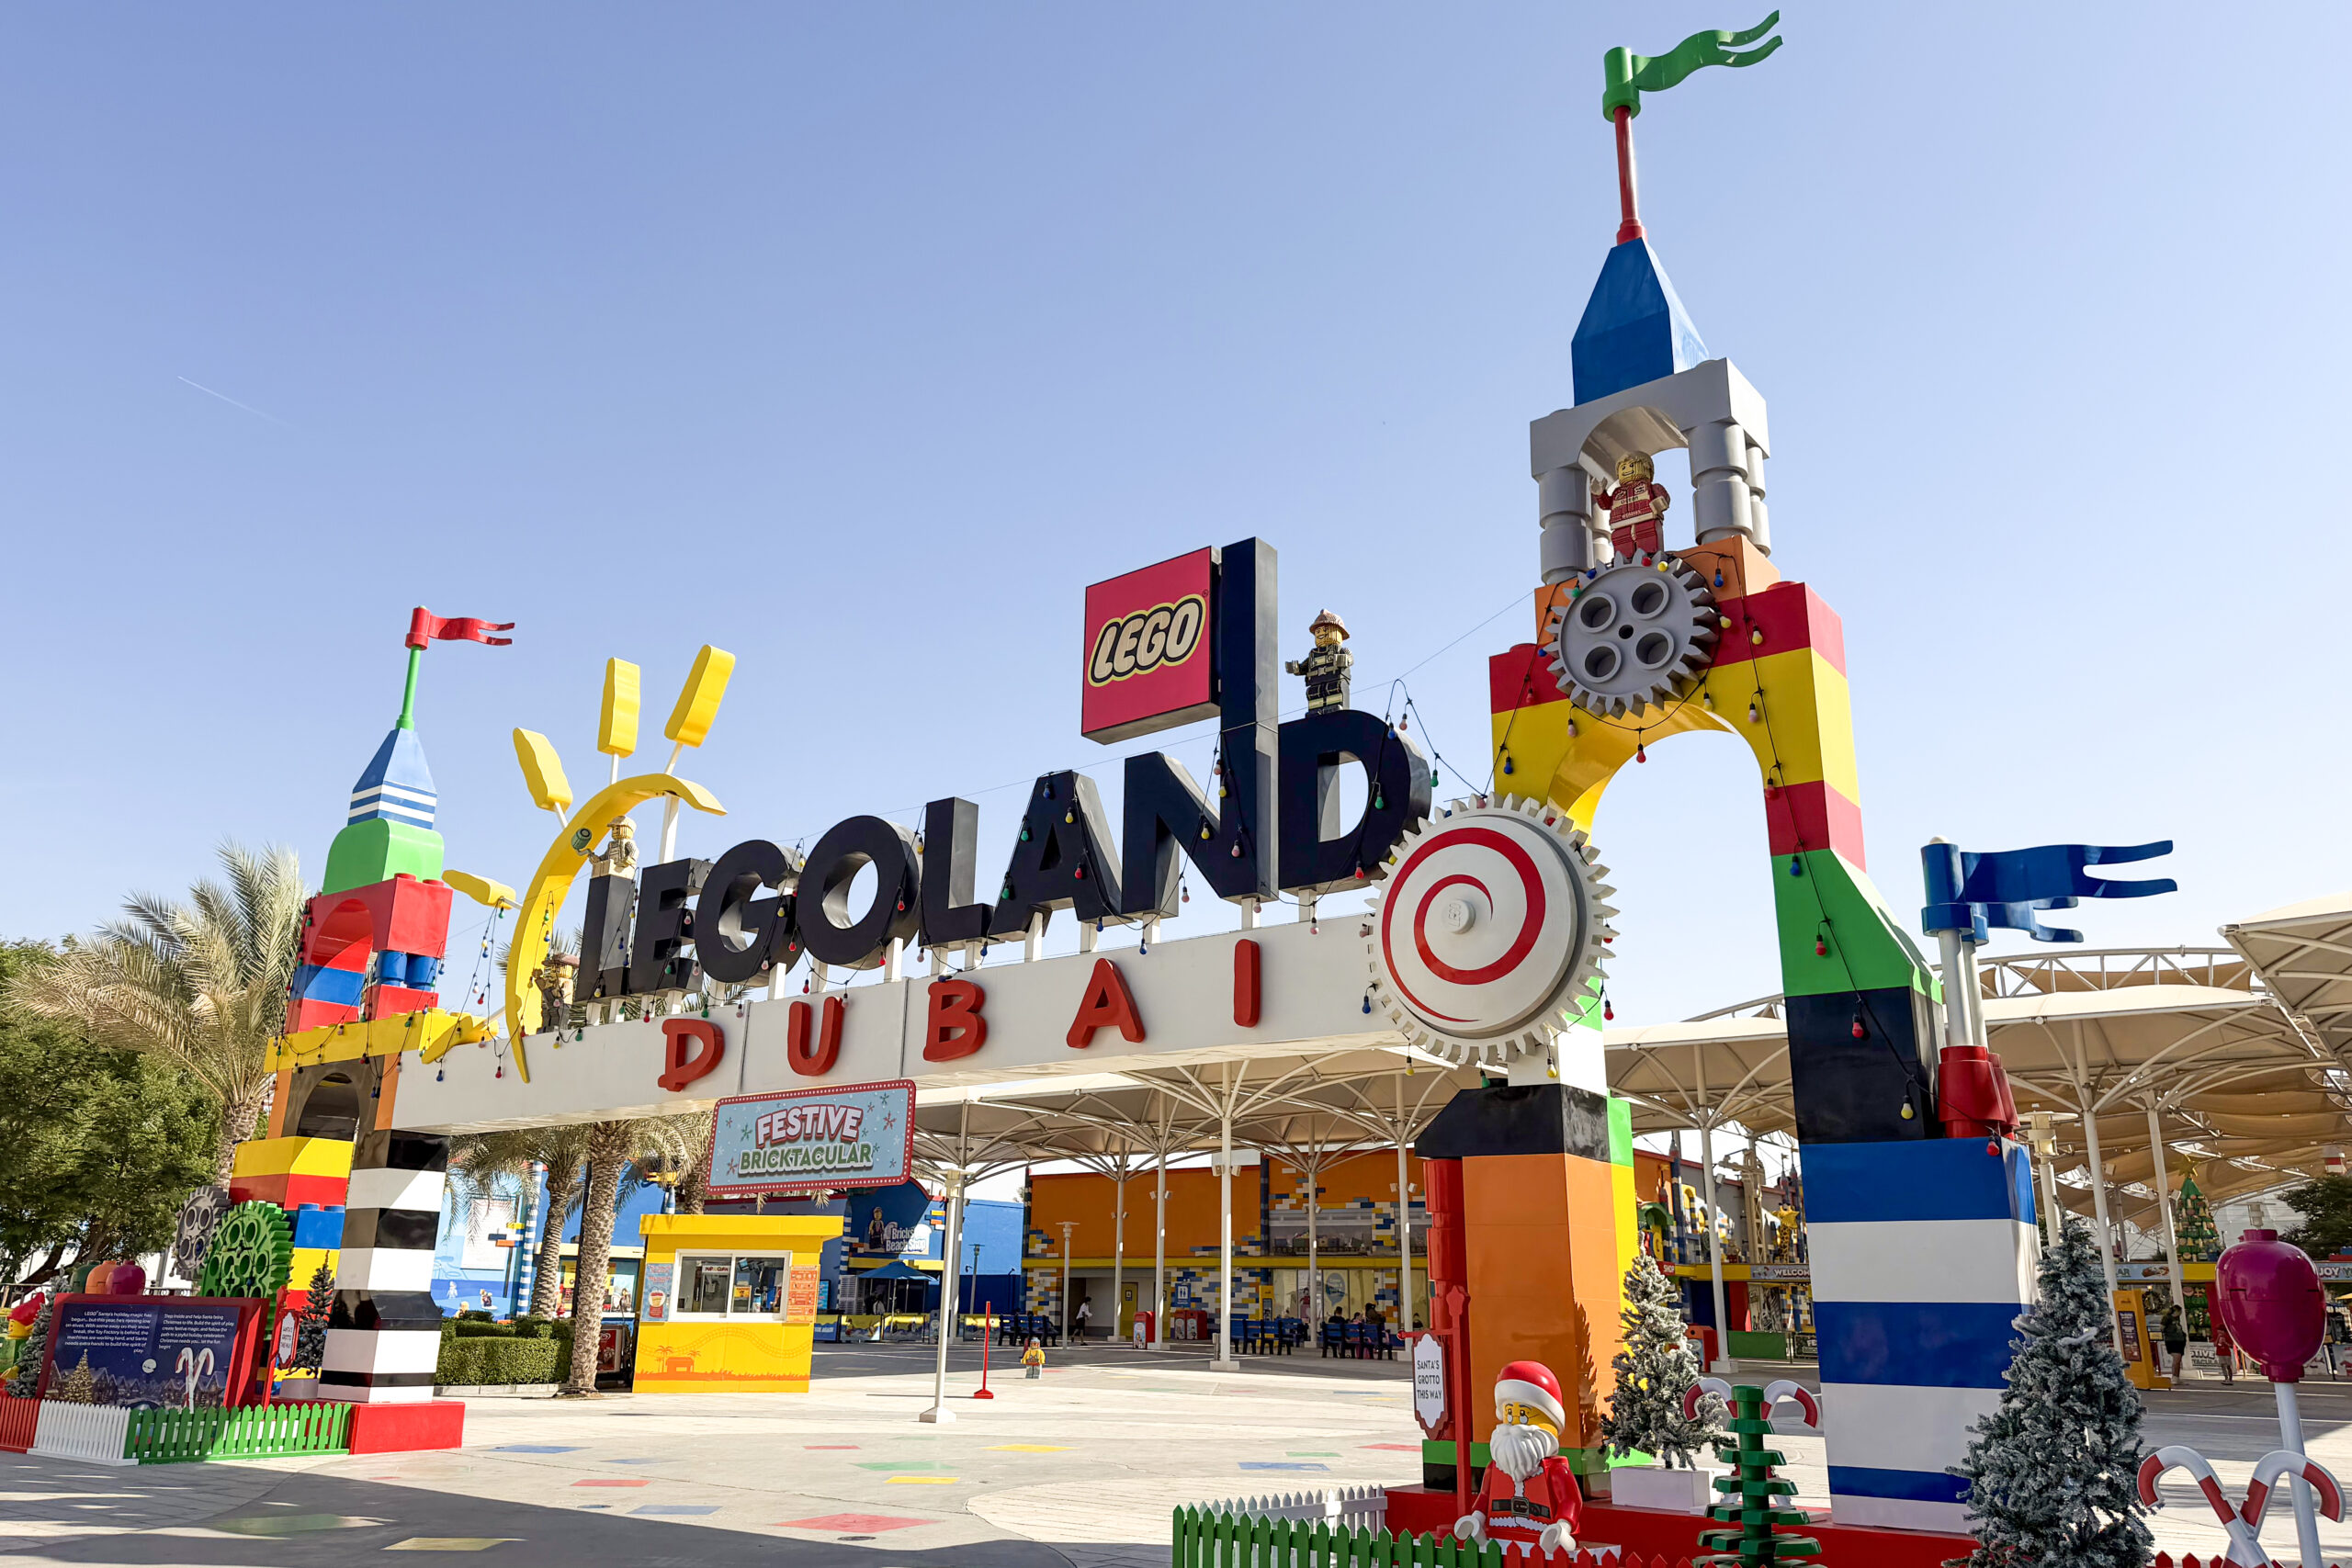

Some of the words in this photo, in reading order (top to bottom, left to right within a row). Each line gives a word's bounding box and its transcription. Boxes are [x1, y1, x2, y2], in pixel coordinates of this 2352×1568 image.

[1091, 597, 1203, 683] LEGO
[573, 537, 1430, 1002] LEGOLAND
[658, 939, 1260, 1091] DUBAI
[756, 1104, 864, 1148] FESTIVE
[739, 1142, 873, 1176] BRICKTACULAR
[1417, 1360, 1440, 1370] SANTA'S
[1418, 1375, 1440, 1384] GROTTO
[1417, 1390, 1429, 1399] THIS
[1430, 1390, 1442, 1399] WAY
